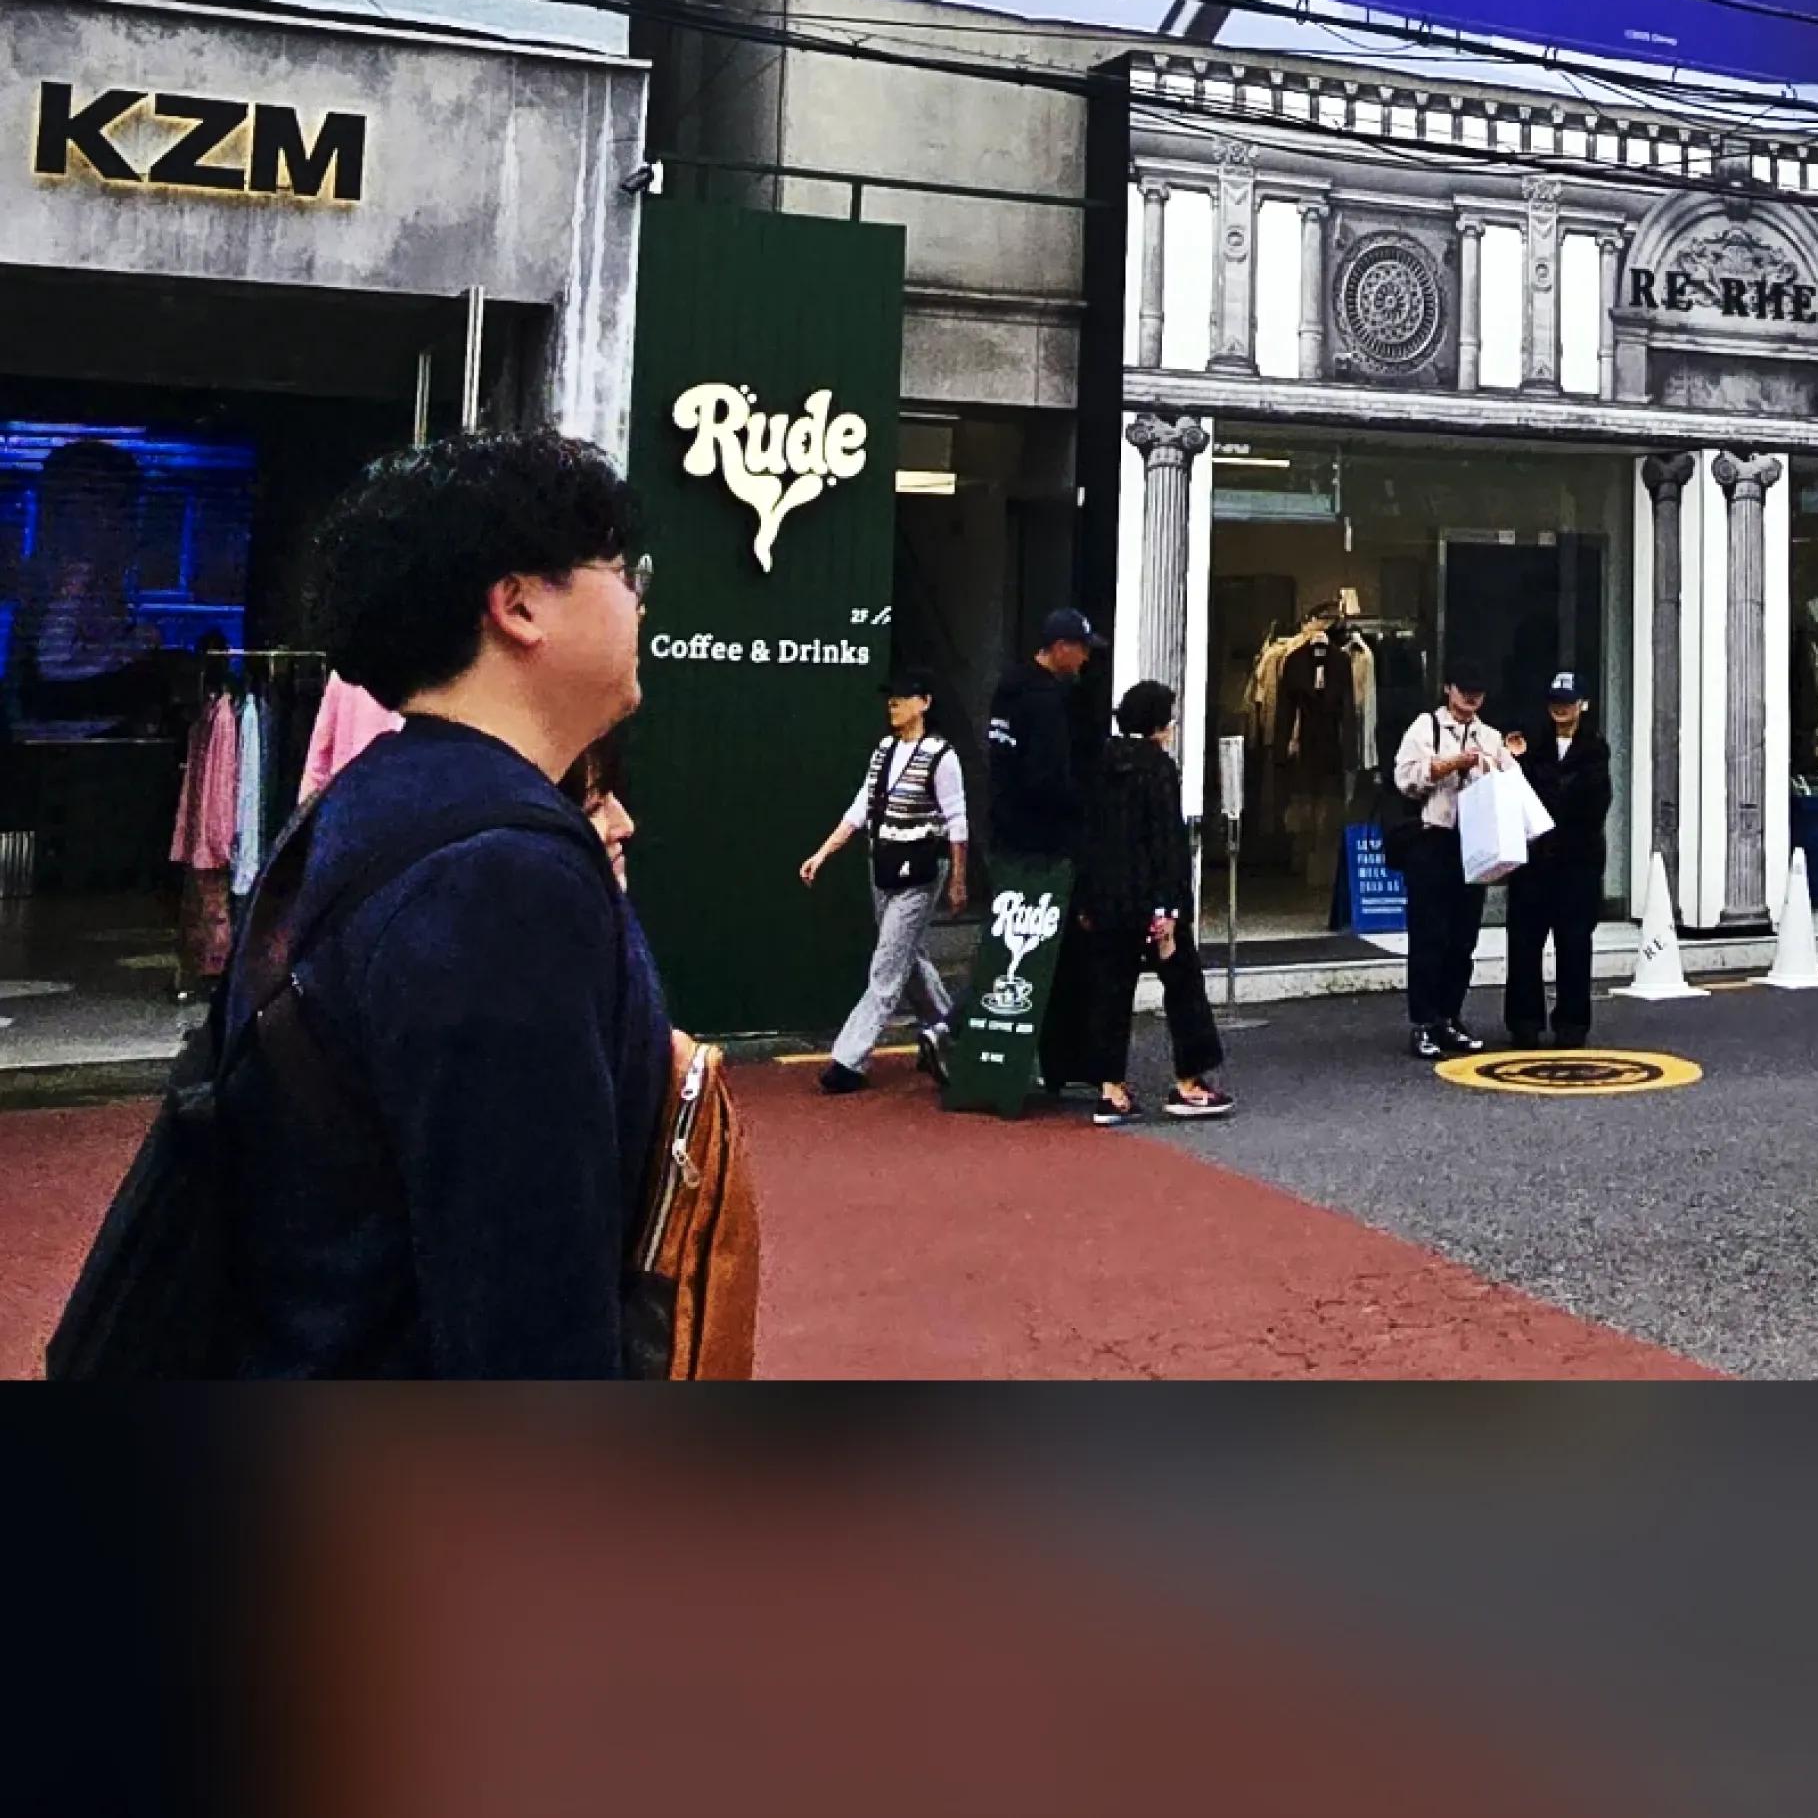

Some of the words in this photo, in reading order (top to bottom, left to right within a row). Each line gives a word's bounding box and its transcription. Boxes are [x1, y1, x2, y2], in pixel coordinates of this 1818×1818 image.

[34, 81, 367, 202] KZM
[672, 382, 867, 507] Rude
[650, 632, 743, 662] Coffee
[750, 638, 771, 663] &
[777, 637, 870, 666] Drinks
[990, 889, 1061, 952] Rude
